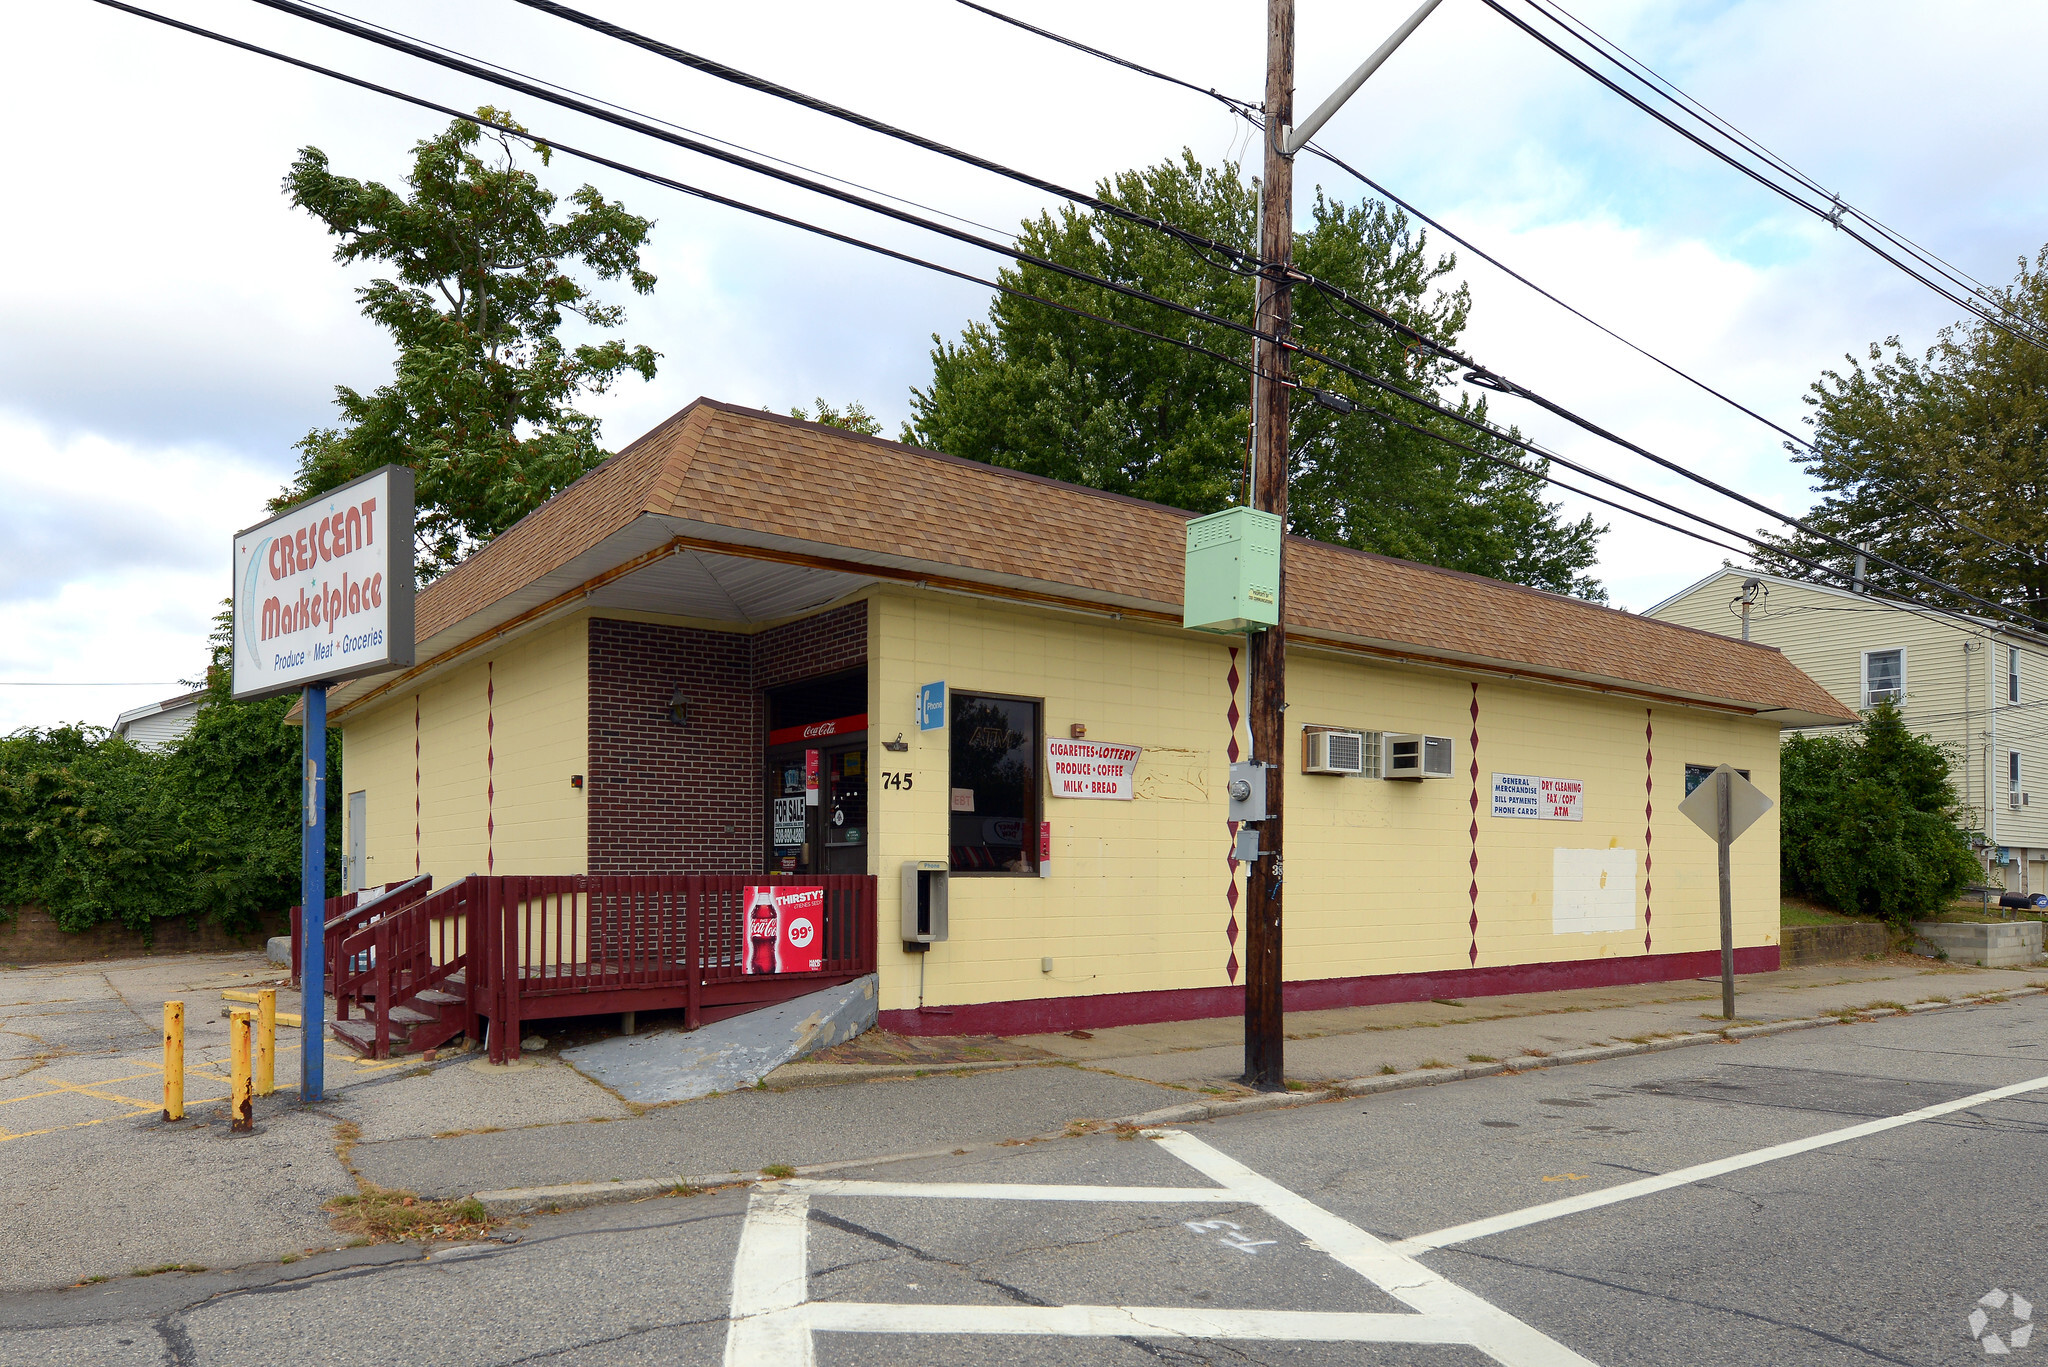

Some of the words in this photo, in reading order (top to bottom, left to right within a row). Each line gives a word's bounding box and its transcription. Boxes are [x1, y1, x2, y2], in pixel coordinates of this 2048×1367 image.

[268, 497, 377, 581] CRESCENT
[261, 572, 383, 642] Marketplace
[273, 650, 305, 672] Produce
[313, 643, 333, 662] Meat
[342, 628, 383, 654] Groceries
[926, 701, 942, 710] Phone
[804, 722, 836, 738] Coca-Cola
[968, 727, 1012, 749] ATM
[1050, 743, 1095, 758] CIGARETTES
[1098, 746, 1136, 761] LOTTERY
[1056, 762, 1091, 776] PRODUCE
[1097, 764, 1124, 777] COFFEE
[882, 772, 913, 790] 745
[1064, 780, 1083, 792] MILK
[1092, 782, 1117, 794] BREAD
[1502, 777, 1530, 786] GENERAL
[1542, 780, 1553, 791] DRY
[1555, 782, 1582, 793] CLEANING
[1495, 784, 1537, 794] MERCHANDISE
[954, 795, 972, 806] EBT
[1508, 796, 1537, 805] PAYMENTS
[774, 800, 788, 823] FOR
[788, 798, 804, 822] SALE
[1518, 807, 1537, 815] CARDS
[1554, 806, 1569, 816] ATM
[776, 890, 824, 906] THIRSTY?
